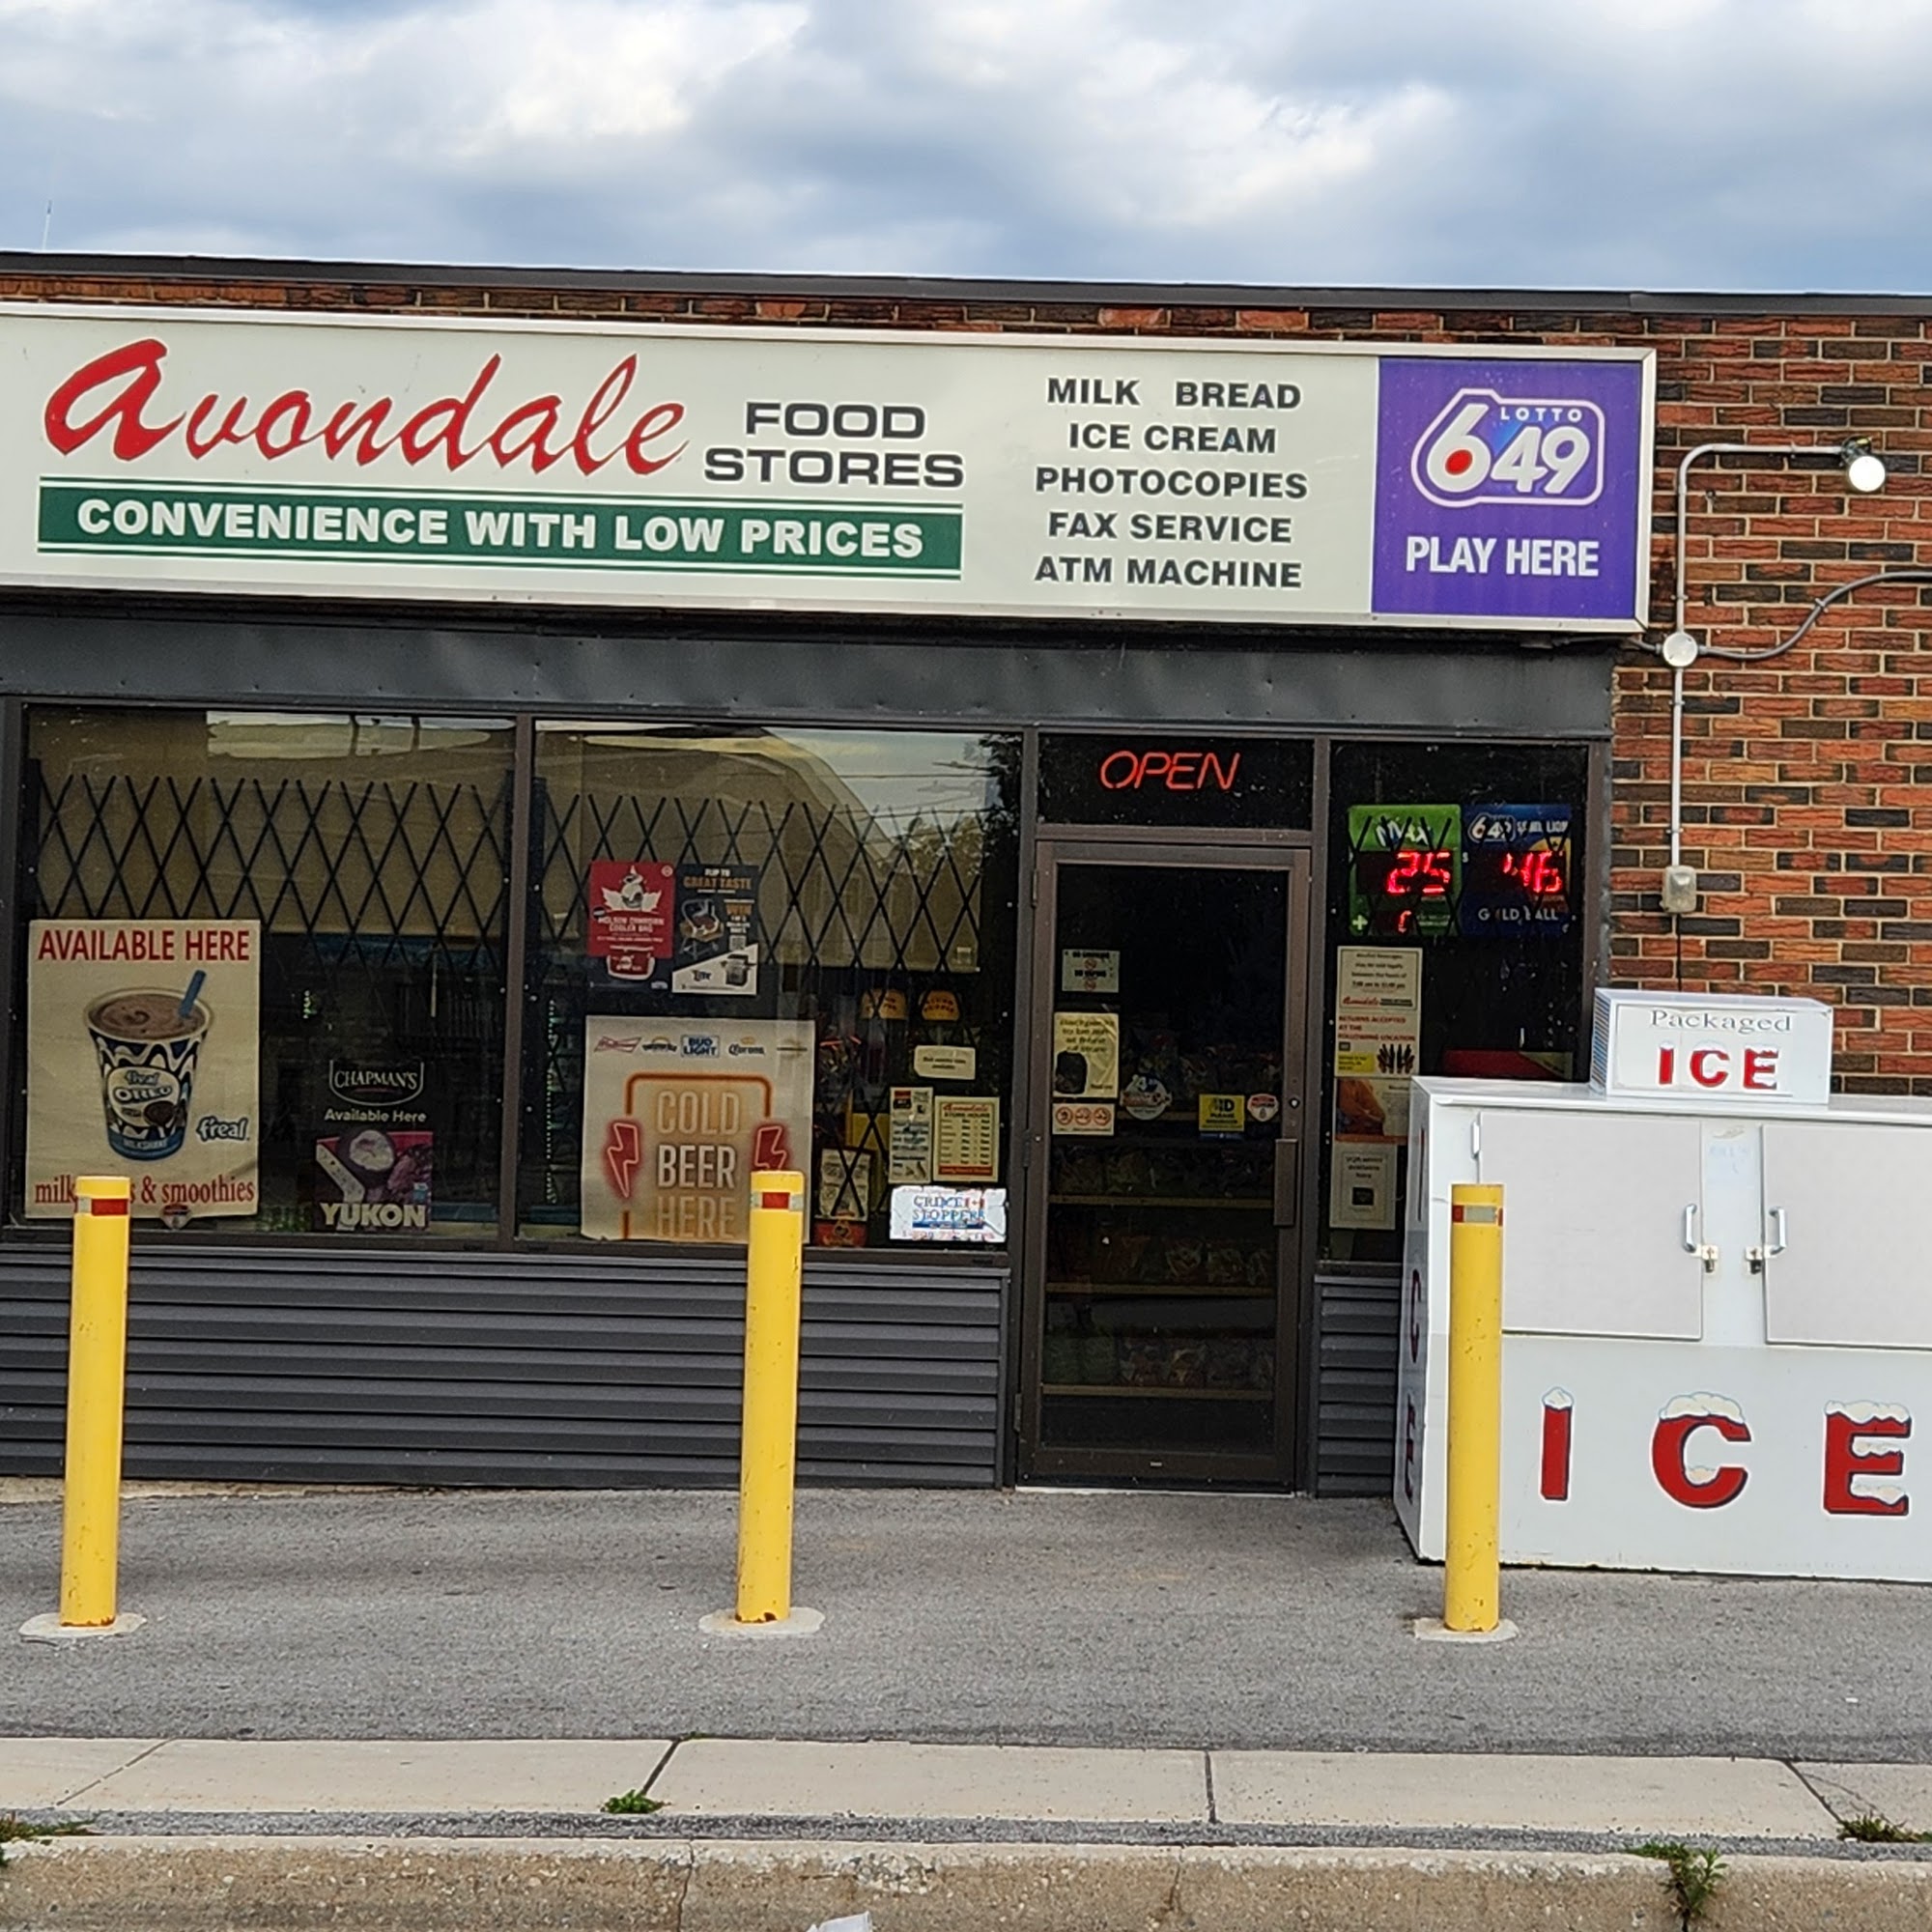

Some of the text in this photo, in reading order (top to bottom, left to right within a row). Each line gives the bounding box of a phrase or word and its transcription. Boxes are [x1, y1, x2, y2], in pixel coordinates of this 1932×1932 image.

[1047, 378, 1302, 410] MILK BREAD
[745, 401, 926, 440] FOOD
[1499, 406, 1583, 423] LOTTO
[1069, 422, 1276, 454] ICE CREAM
[705, 447, 964, 488] STORES
[1035, 468, 1308, 499] PHOTOCOPIES
[77, 498, 924, 558] CONVENIENCE WITH LOW PRICES
[1048, 512, 1293, 543] FAX SERVICE
[1035, 556, 1302, 589] ATM MACHINE
[1406, 536, 1600, 577] PLAY HERE
[1099, 750, 1240, 790] OPEN
[1387, 851, 1451, 894] 25
[1478, 907, 1520, 920] GLD
[38, 929, 250, 961] AVAILABLE HERE
[1649, 1009, 1792, 1033] Packaged
[682, 1037, 718, 1056] BUD LIGHT
[727, 1044, 766, 1057] Corona
[334, 1069, 418, 1090] CHAPMAN'S
[1657, 1039, 1779, 1090] ICE
[113, 1086, 174, 1103] OREO
[324, 1108, 427, 1122] Available Here
[656, 1089, 741, 1135] COLD
[657, 1145, 736, 1189] BEER
[141, 1175, 158, 1203] &
[161, 1172, 255, 1203] smoothies
[320, 1203, 426, 1229] YUKON
[657, 1195, 735, 1239] HERE
[1539, 1385, 1912, 1517] ICE
